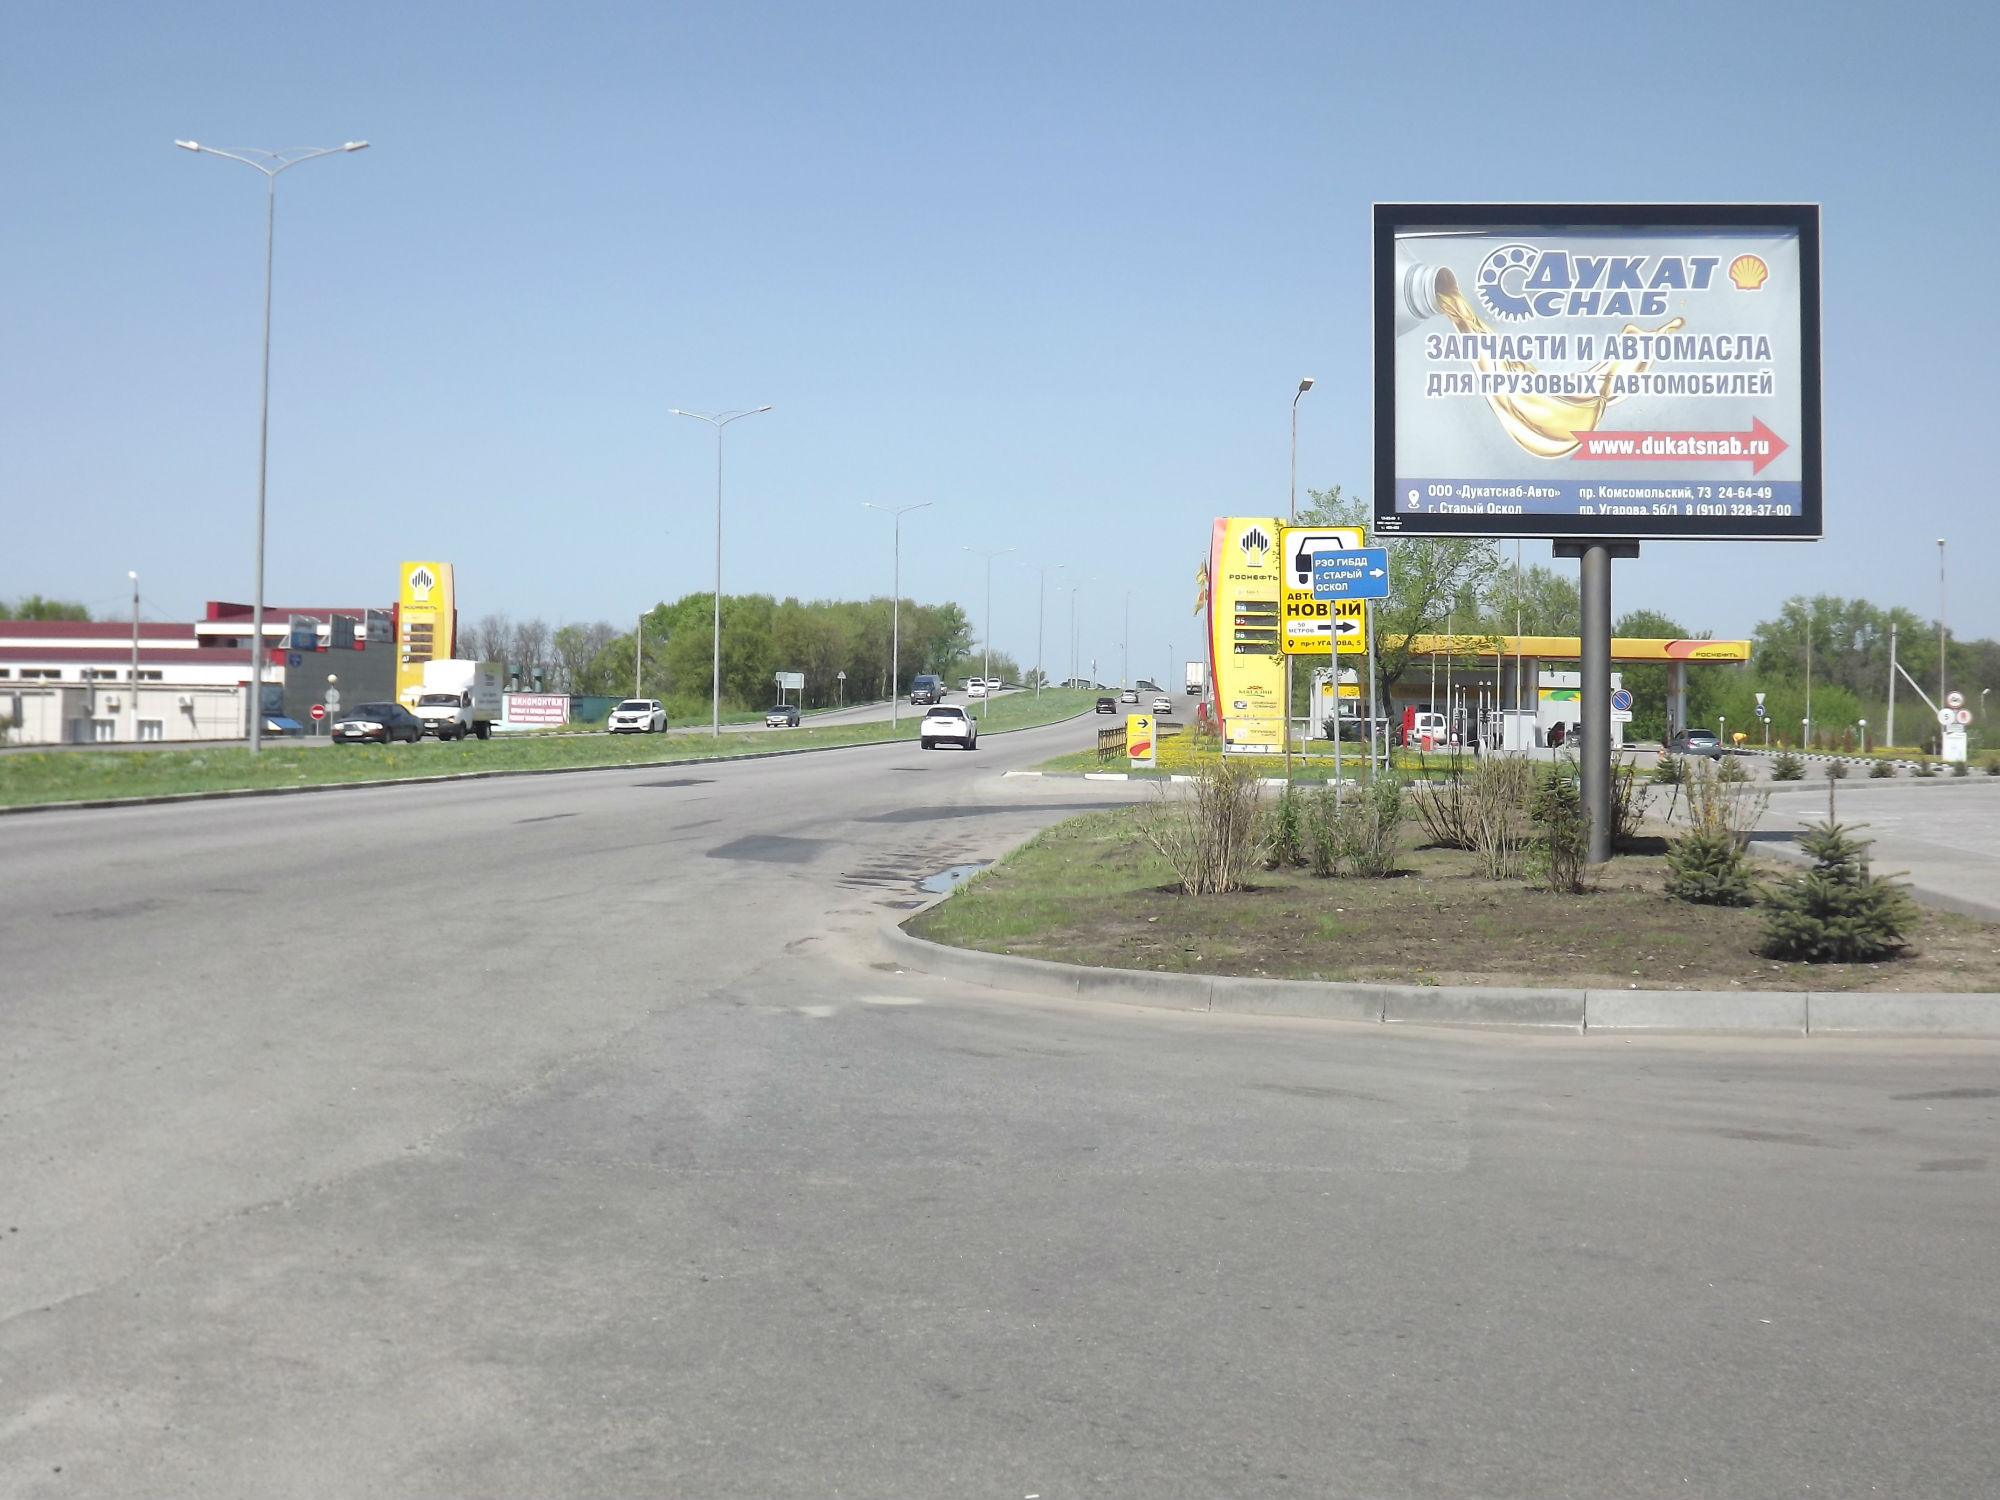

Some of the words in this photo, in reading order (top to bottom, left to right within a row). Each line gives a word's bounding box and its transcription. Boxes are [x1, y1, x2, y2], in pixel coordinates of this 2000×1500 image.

[1524, 250, 1720, 290] ДУКАТ
[1533, 290, 1668, 317] СНАБ
[1427, 335, 1566, 360] ЗАПЧАСТИ
[1577, 337, 1593, 360] И
[1603, 335, 1772, 361] АВТОМАСЛА
[1427, 374, 1473, 396] ДЛЯ
[1481, 374, 1597, 394] ГРУЗОВЫХ
[1613, 371, 1773, 395] АВТОМОБИЛЕЙ
[1588, 436, 1769, 455] www.dukatsnab.ru
[1428, 485, 1452, 497] ООО
[1456, 485, 1561, 499] «Дукатснаб-Авто»
[1579, 488, 1596, 500] пр.
[1599, 486, 1694, 499] Комсомольский,
[1697, 486, 1712, 498] 73
[1718, 487, 1772, 498] 24-64-49
[1428, 504, 1437, 513] г.
[1440, 502, 1483, 514] Старый
[1487, 503, 1522, 514] Оскол
[1686, 504, 1693, 515] 8
[1697, 503, 1726, 516] (910)
[1730, 504, 1792, 516] 328-37-00
[1315, 559, 1335, 567] РЭО
[1337, 557, 1368, 567] ГИБДД
[1323, 569, 1362, 580] СТАРЫЙ
[1316, 583, 1348, 592] ОСКОЛ
[511, 697, 563, 707] ШИНОМОНТАЖ
